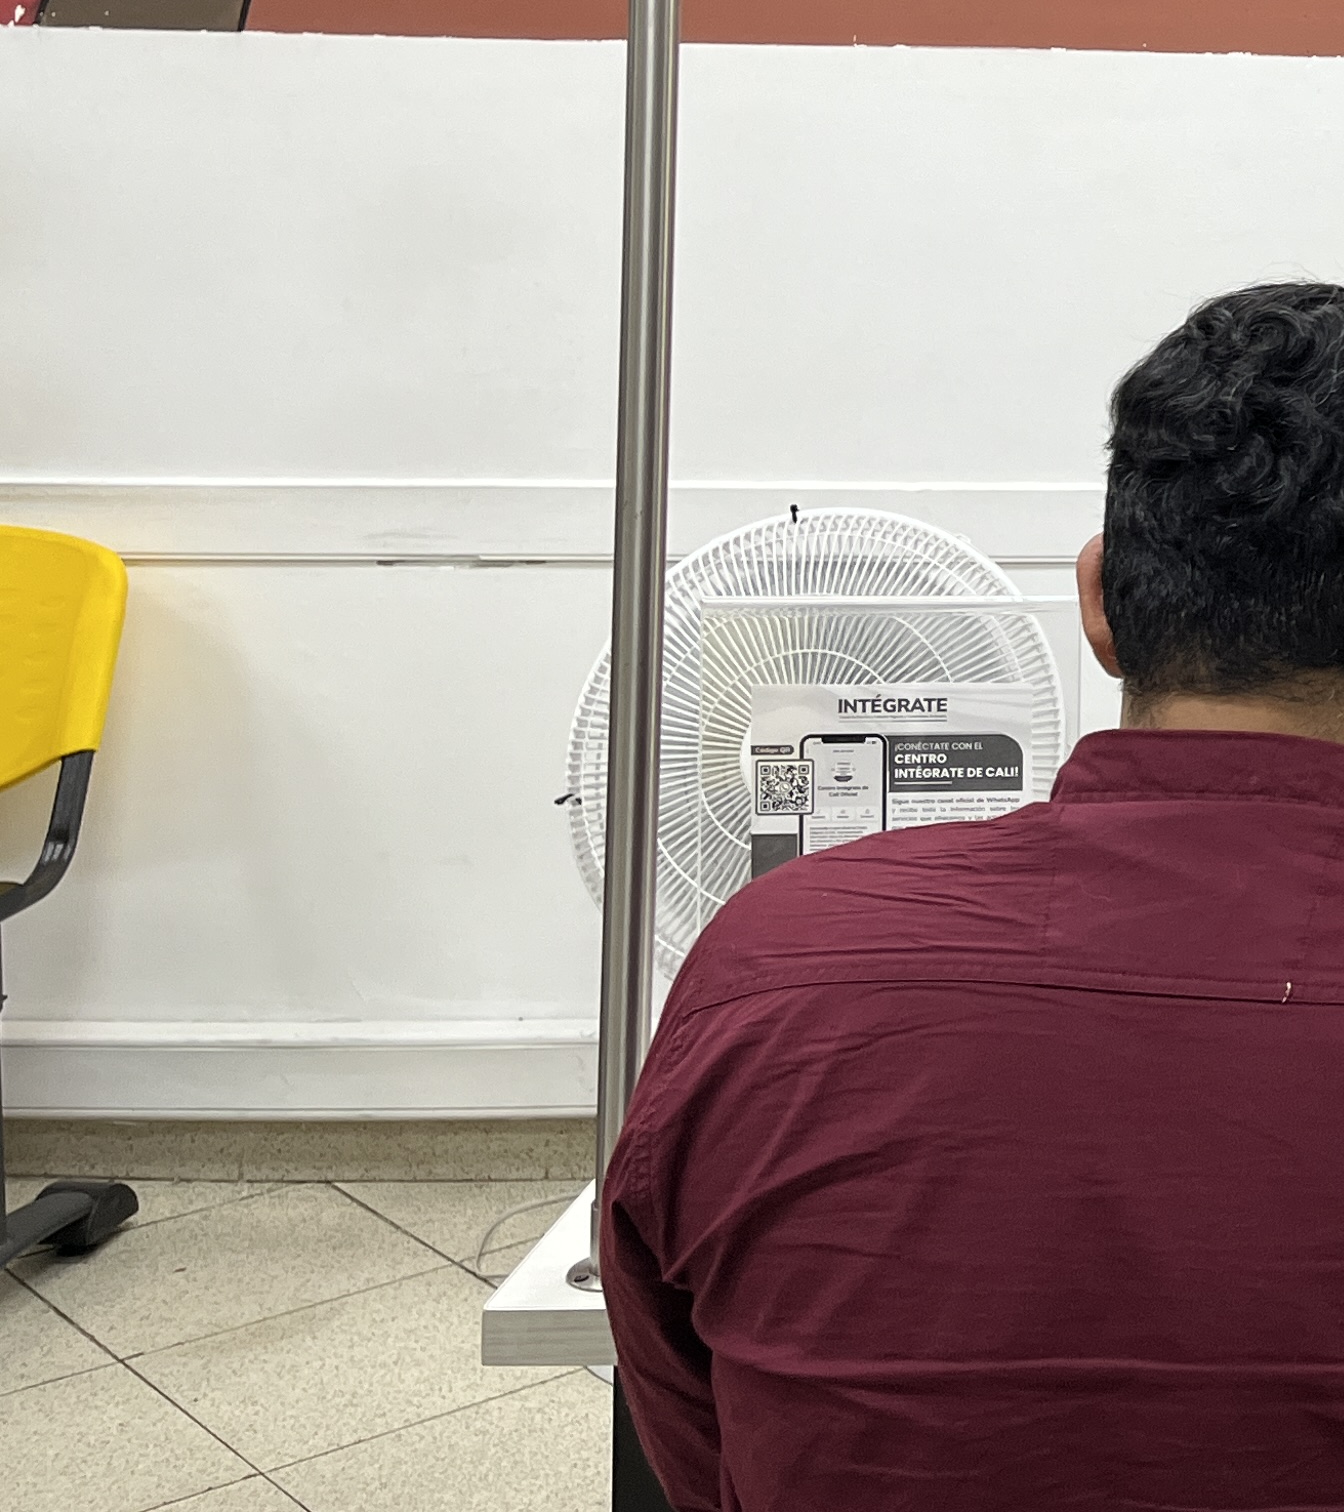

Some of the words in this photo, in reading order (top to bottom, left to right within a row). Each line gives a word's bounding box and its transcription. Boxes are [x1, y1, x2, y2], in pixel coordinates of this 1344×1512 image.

[838, 694, 947, 714] INTÉGRATE
[895, 742, 949, 752] ¡CONÉCTATE
[974, 742, 983, 750] EL
[894, 754, 947, 764] CENTRO
[894, 765, 964, 778] INTÉGRATE
[967, 768, 982, 777] DE
[985, 767, 1018, 777] CALI!
